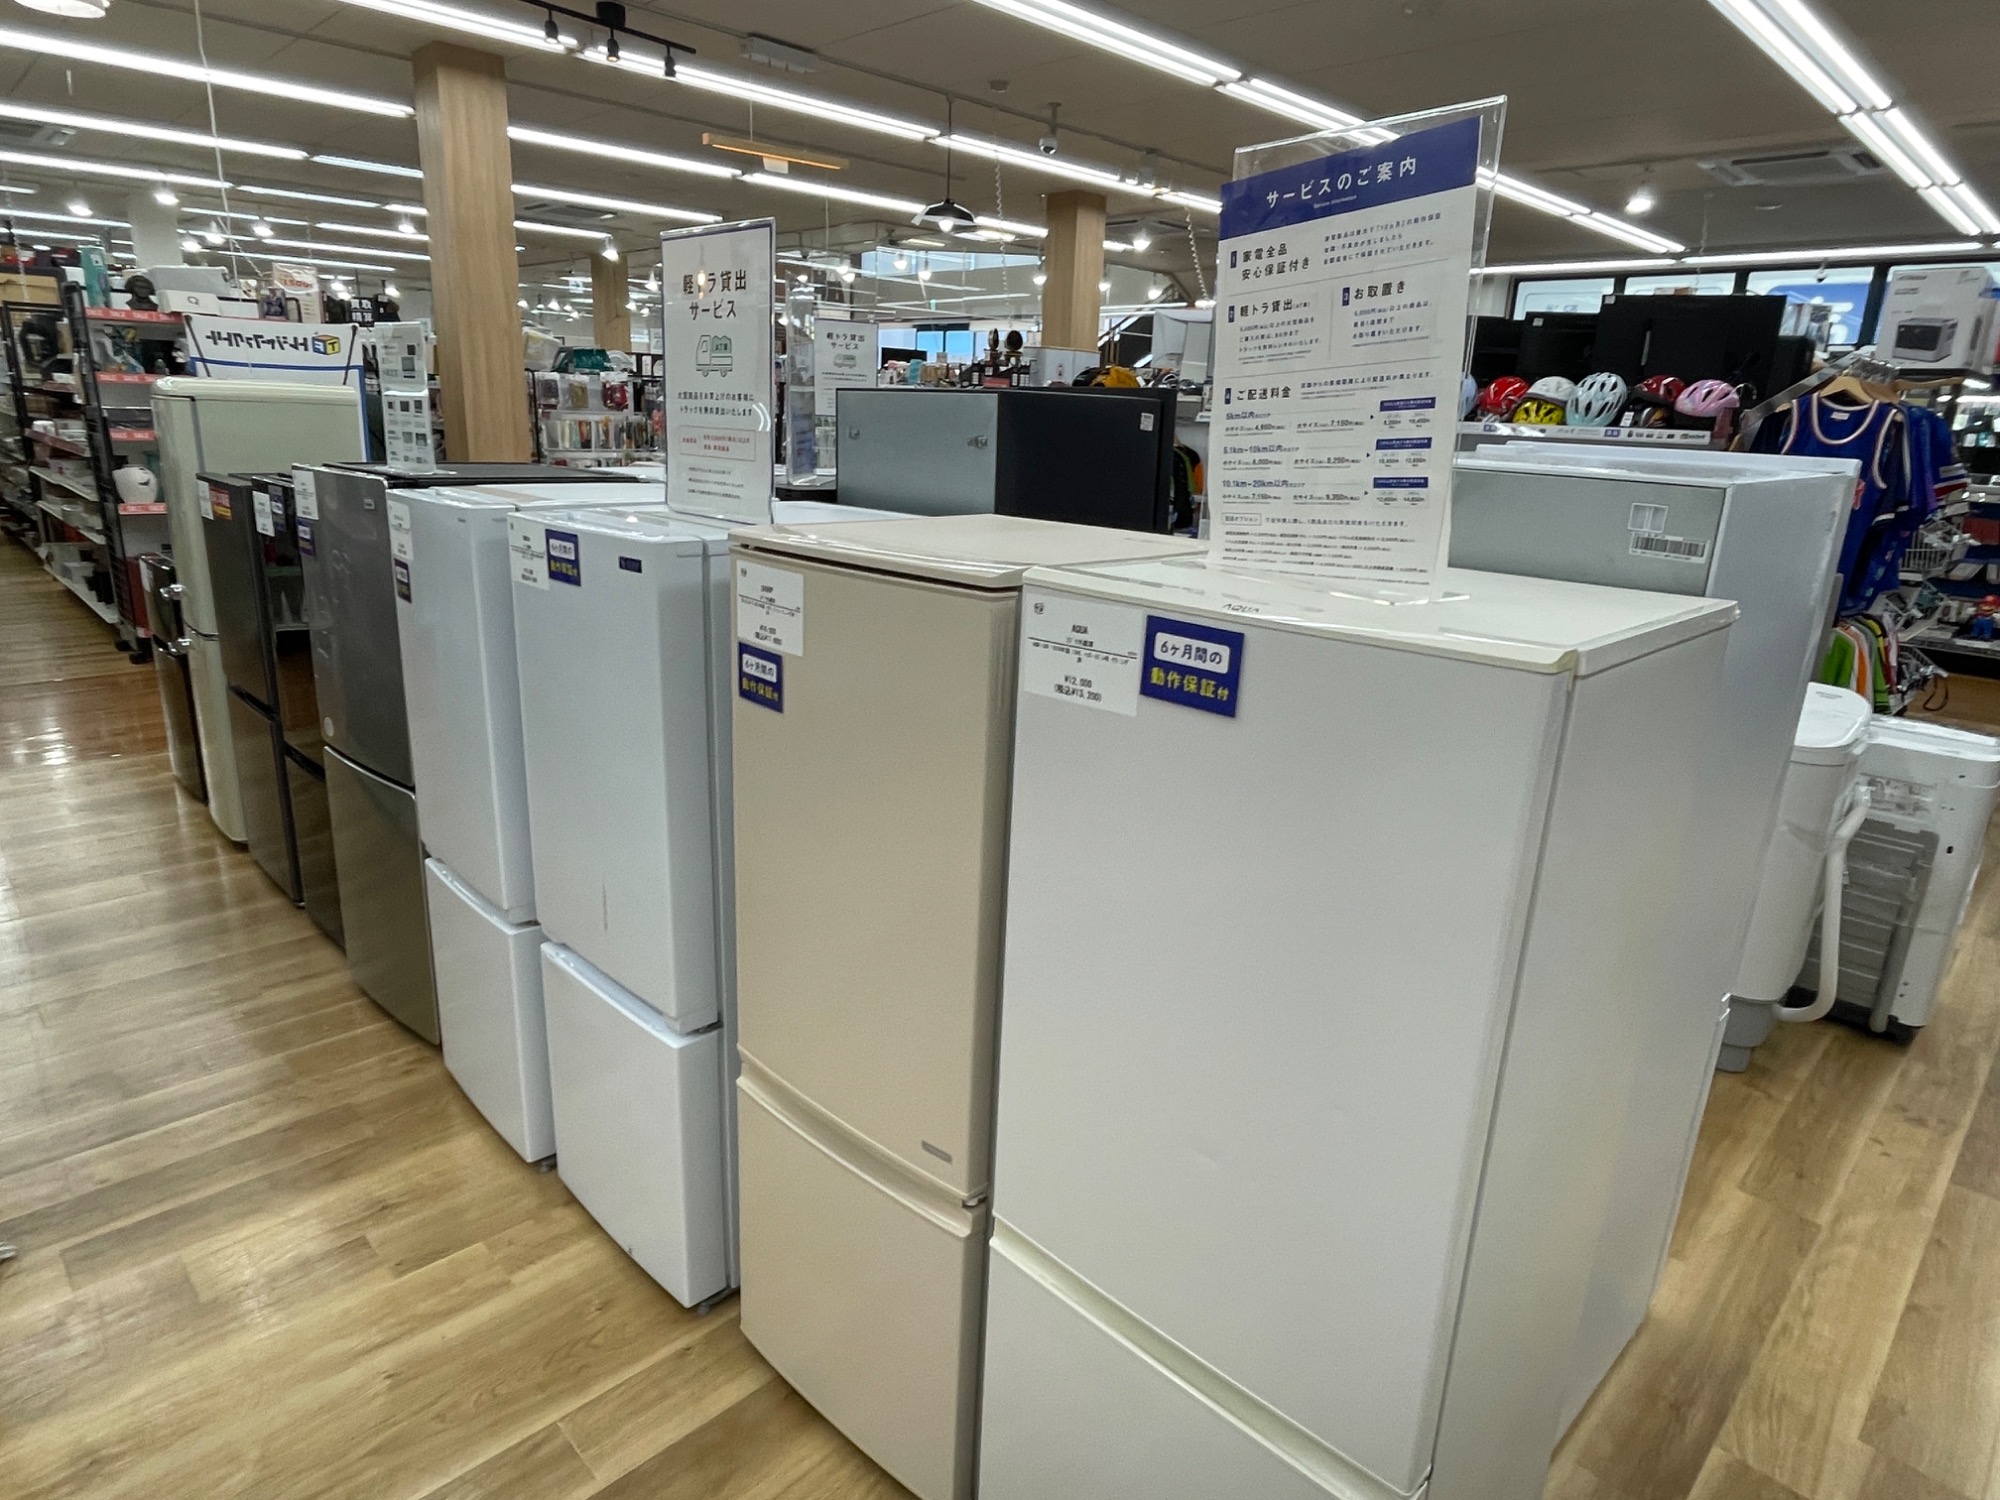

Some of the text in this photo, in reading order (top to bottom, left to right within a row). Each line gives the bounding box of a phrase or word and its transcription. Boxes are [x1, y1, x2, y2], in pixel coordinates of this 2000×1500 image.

[1266, 154, 1417, 208] サービスのご案内
[1242, 243, 1288, 263] 家電全品
[1241, 257, 1310, 281] 安心保証付き
[1354, 281, 1406, 300] お取置き
[689, 299, 737, 321] サービス
[1240, 298, 1293, 317] 軽トラ貸出
[830, 342, 859, 350] サービス
[1236, 386, 1292, 401] ご配送料金
[1222, 603, 1260, 613] AQUA
[1150, 666, 1229, 702] 動作保証付
